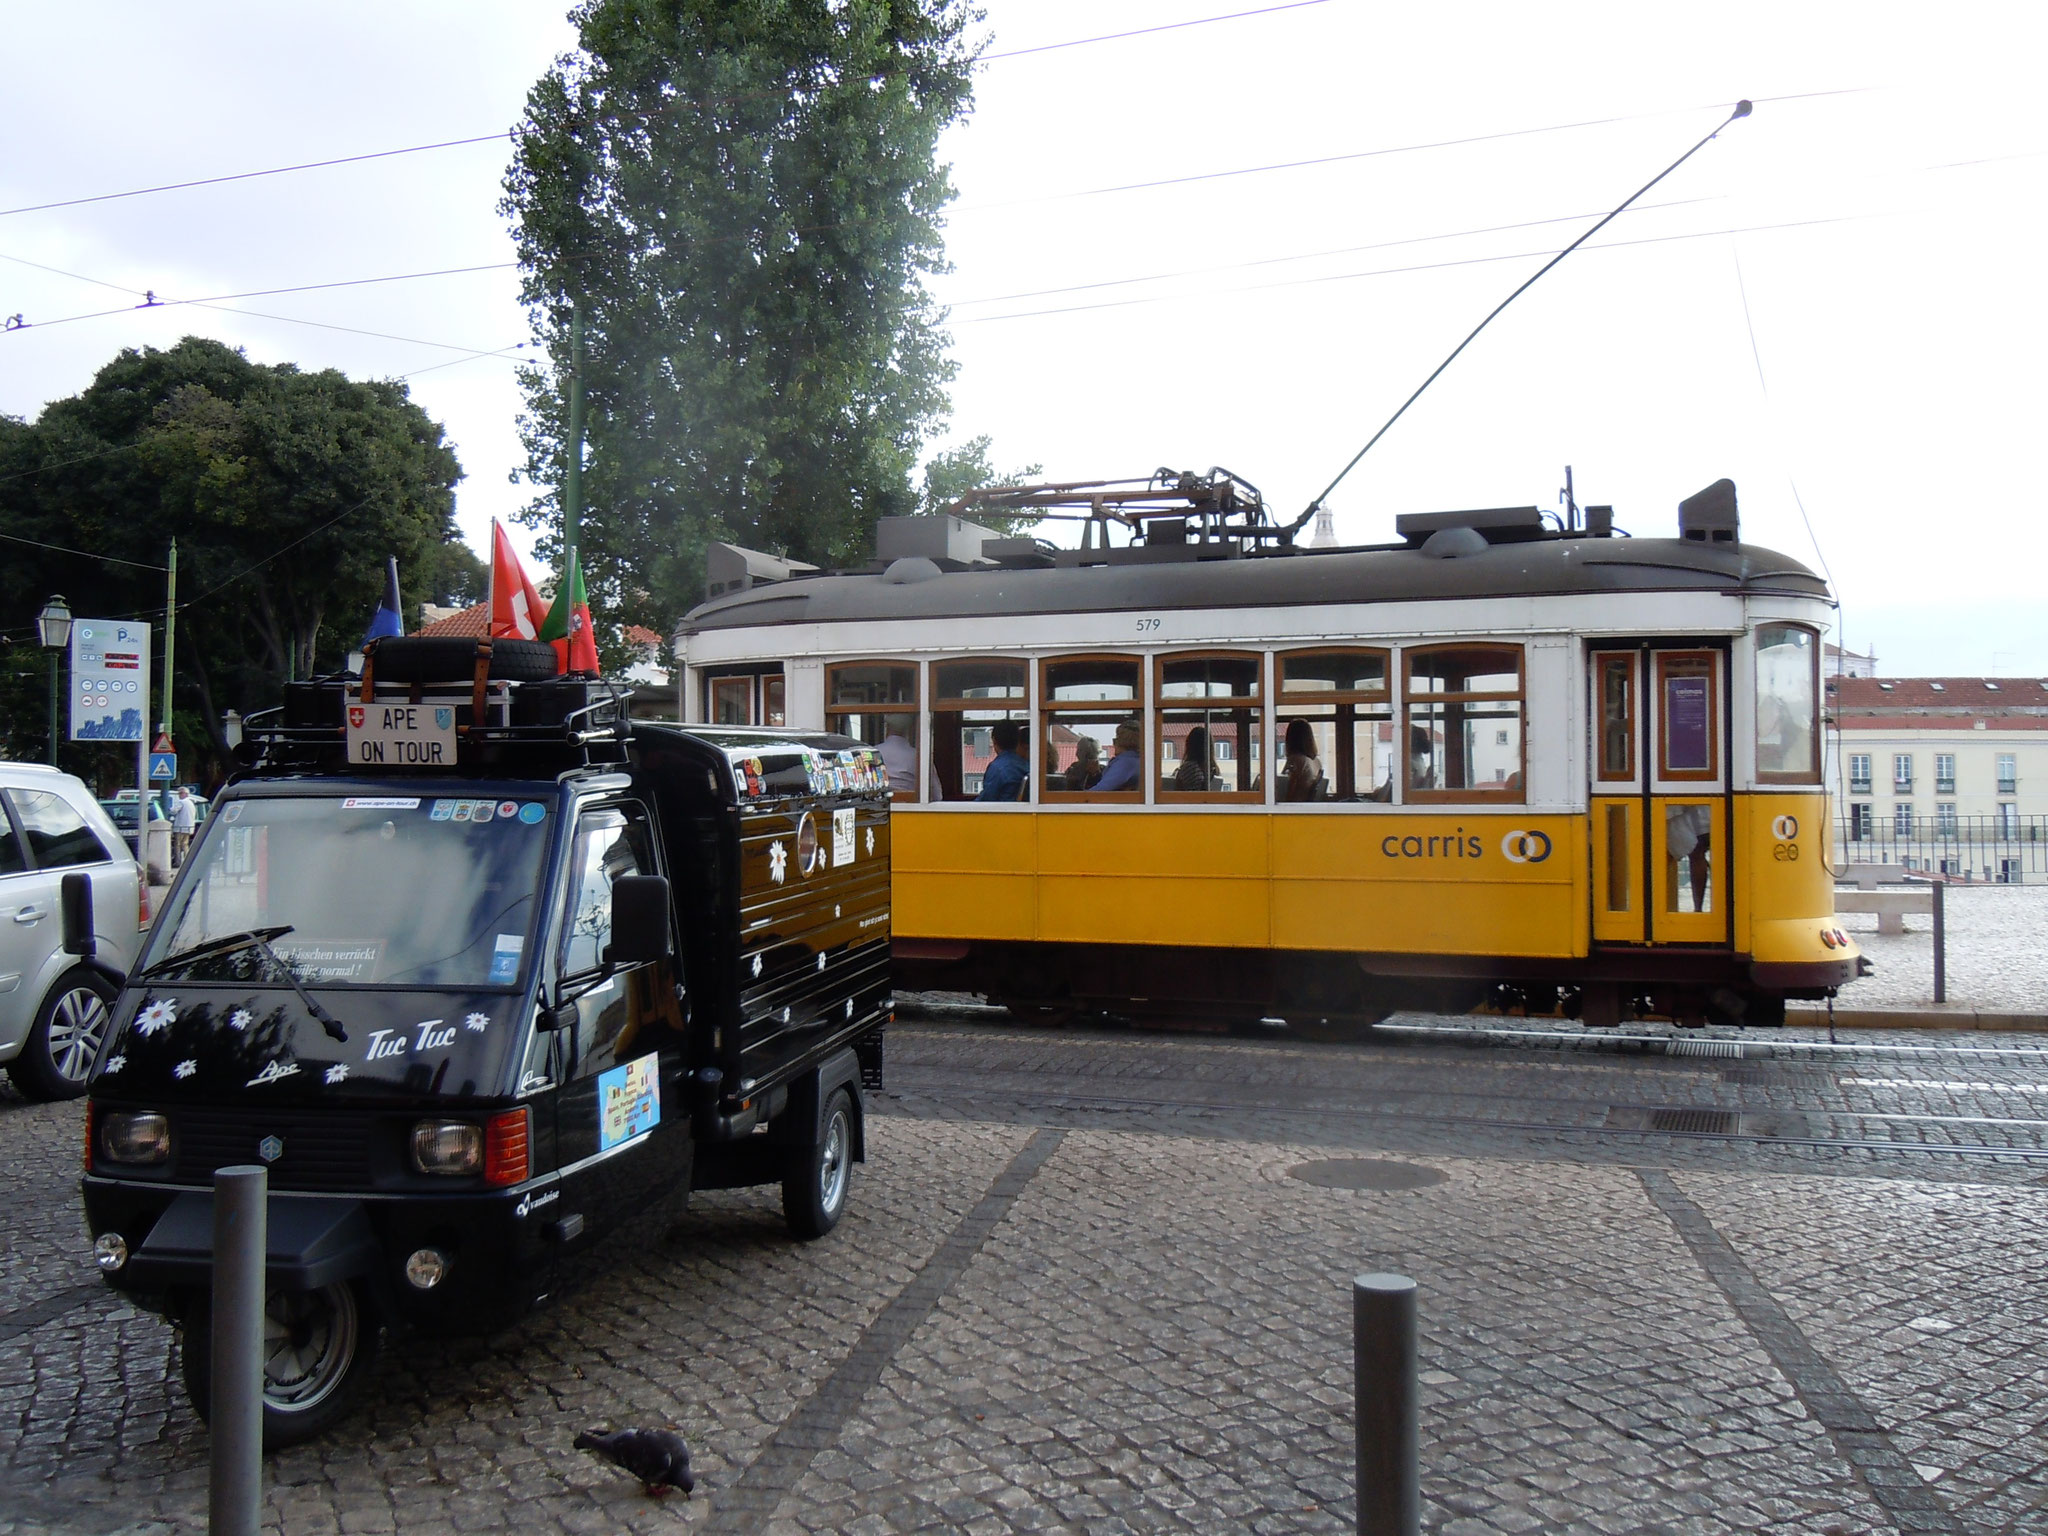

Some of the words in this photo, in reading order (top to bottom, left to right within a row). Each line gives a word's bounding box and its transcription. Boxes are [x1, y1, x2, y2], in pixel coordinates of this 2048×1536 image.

[117, 630, 128, 642] P
[1136, 618, 1161, 632] 579
[383, 708, 418, 730] APE
[361, 740, 384, 762] ON
[394, 741, 442, 763] TOUR
[1381, 827, 1483, 858] carris
[335, 947, 376, 960] verrückt
[319, 964, 355, 976] normal
[366, 1028, 408, 1061] Tuc
[415, 1019, 456, 1050] Tuc
[256, 1059, 300, 1084] Ape
